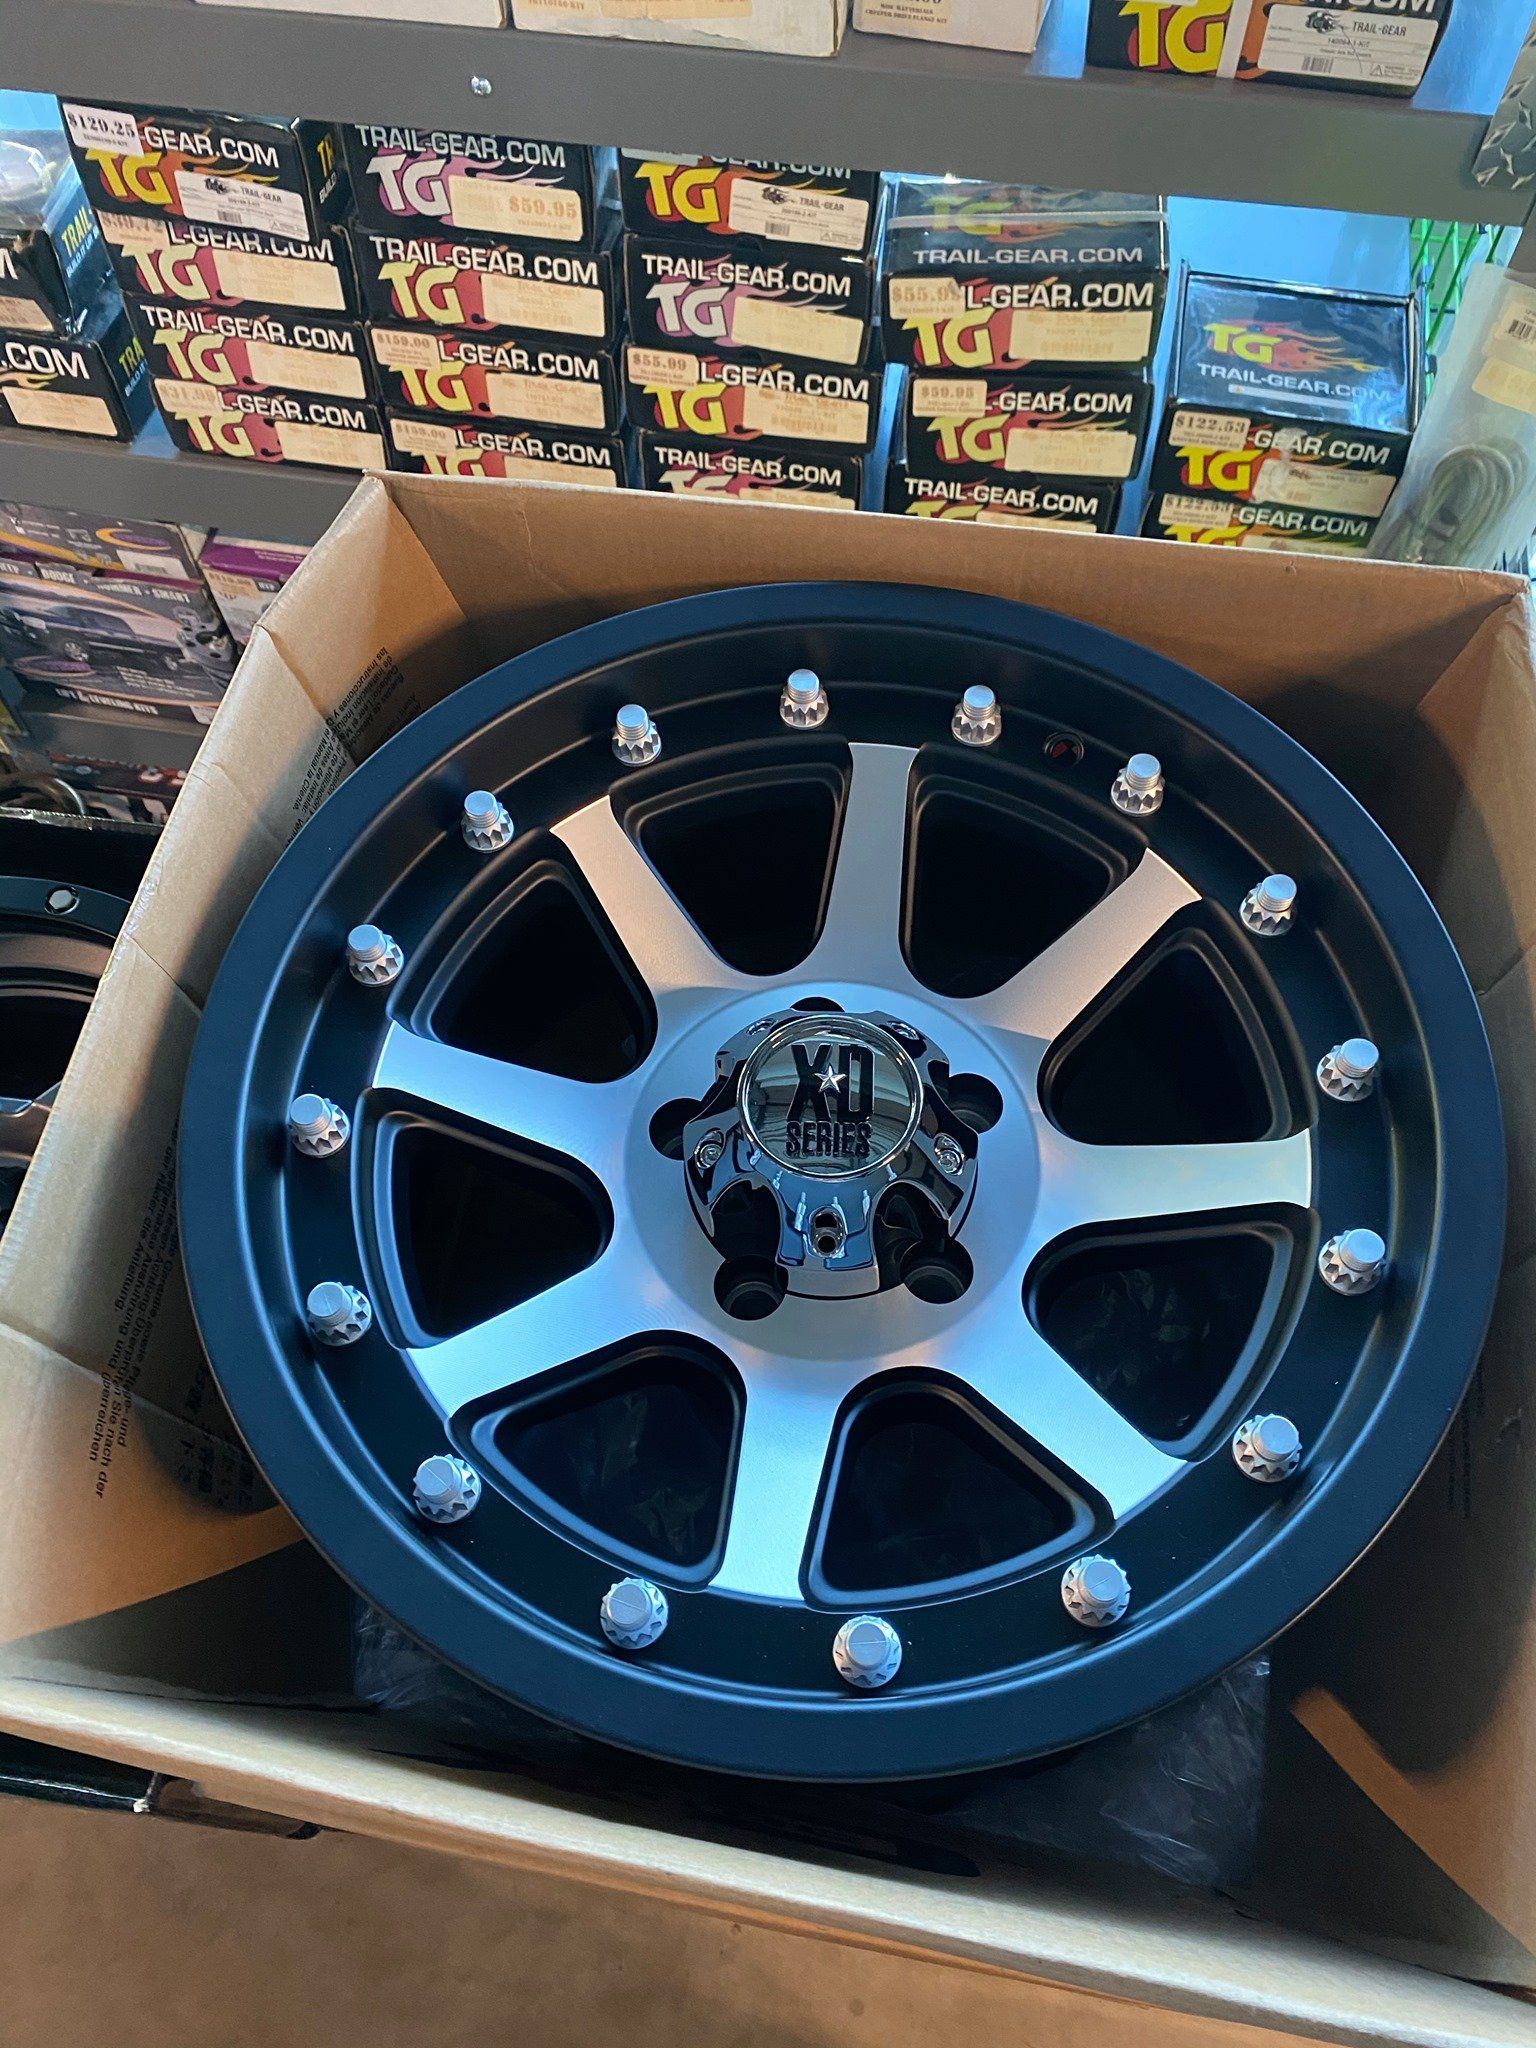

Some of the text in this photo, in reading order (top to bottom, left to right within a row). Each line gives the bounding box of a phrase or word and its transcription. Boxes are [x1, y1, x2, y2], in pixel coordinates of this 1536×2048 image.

[67, 111, 136, 138] $120.25
[355, 124, 567, 168] TRAIL-GEAR.COM
[139, 126, 280, 169] -GEAR.COM
[85, 147, 173, 206] TG
[366, 152, 452, 217] TG
[635, 161, 722, 224] TG
[167, 221, 335, 262] L-GEAR.COM
[369, 235, 600, 286] TRAIL-GEAR.COM
[912, 247, 1144, 266] TRAIL-GEAR.COM
[120, 244, 211, 301] TG
[377, 260, 467, 325] TG
[641, 253, 851, 297] TRAIL-GEAR.COM
[140, 304, 356, 353] TRAIL-GEAR.COM
[646, 281, 730, 338] TG
[153, 328, 238, 387] TG
[902, 306, 994, 368] TG
[1202, 322, 1284, 365] TG
[437, 339, 600, 381] L-GEAR.COM
[699, 361, 870, 401] L-GEAR.COM
[1196, 362, 1391, 401] TRAIL-GEAR.COM
[388, 360, 474, 413] TG
[643, 381, 729, 436] TG
[984, 391, 1133, 414] -GEAR.COM
[217, 389, 368, 431] L-GEAR.COM
[174, 410, 256, 458] TG
[456, 430, 612, 467] L-GEAR.COM
[926, 413, 1010, 464] TG
[1246, 427, 1392, 467] -GEAR.COM
[653, 446, 842, 487] TRAIL-GEAR.COM
[1174, 446, 1263, 493] TG
[903, 477, 1098, 516] TRAIL-GEAR.COM
[1230, 506, 1369, 538] -GEAR.COM
[785, 1120, 873, 1159] SERIES
